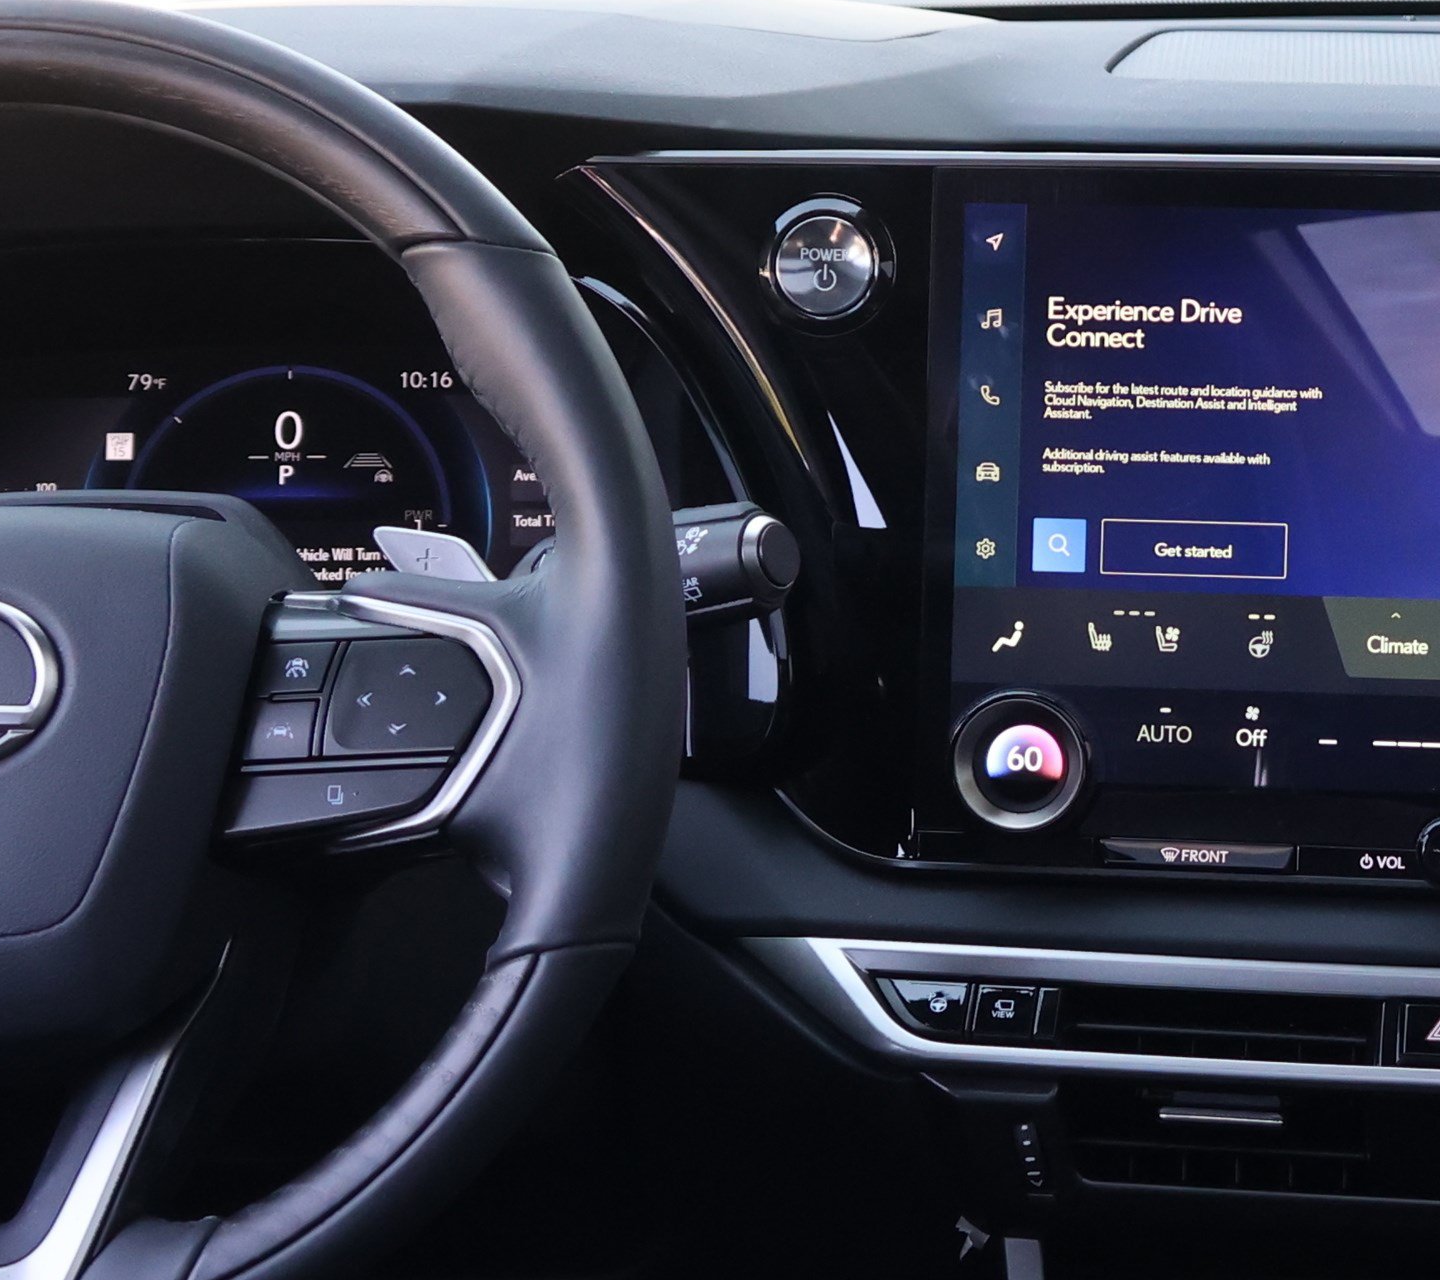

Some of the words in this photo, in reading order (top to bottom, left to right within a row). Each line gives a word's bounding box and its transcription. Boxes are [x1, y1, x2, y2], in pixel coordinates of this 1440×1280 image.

[800, 247, 850, 263] POWER
[1047, 296, 1175, 326] Experience
[1180, 298, 1243, 324] Drive
[1045, 323, 1145, 349] Connect
[400, 371, 453, 389] 10:16
[1044, 380, 1094, 394] Subscribe
[1095, 382, 1110, 395] for
[1112, 382, 1130, 395] the
[1131, 383, 1160, 396] latest
[1160, 384, 1189, 397] route
[1190, 385, 1210, 397] and
[1210, 385, 1251, 398] location
[1252, 386, 1298, 401] guidance
[1300, 387, 1323, 400] with
[1044, 393, 1076, 407] Cloud
[1077, 395, 1134, 410] Navigation,
[1136, 396, 1194, 409] Destination
[1195, 397, 1226, 410] Assist
[1227, 399, 1247, 411] and
[1248, 399, 1298, 414] Intelligent
[1043, 406, 1093, 420] Assistant.
[274, 410, 303, 450] 0
[274, 451, 301, 462] MPH
[1042, 447, 1094, 461] Additional
[1094, 449, 1129, 464] driving
[1130, 451, 1159, 463] assist
[1160, 451, 1202, 464] features
[1203, 452, 1246, 465] available
[1247, 453, 1271, 466] with
[278, 465, 295, 485] P
[513, 469, 538, 481] Ave
[1042, 462, 1106, 475] subscription.
[35, 482, 58, 493] 100
[404, 510, 433, 521] PWR
[513, 515, 543, 527] Total
[331, 548, 354, 561] Will
[355, 548, 381, 561] Turn
[1154, 542, 1183, 558] Get
[1184, 544, 1233, 559] started
[1366, 637, 1430, 657] Climate
[1137, 725, 1193, 744] AUTO
[1235, 728, 1269, 748] Off
[1006, 746, 1044, 772] 60
[1181, 849, 1229, 864] FRONT
[1376, 855, 1406, 870] VOL
[991, 1010, 1016, 1019] VIEW
